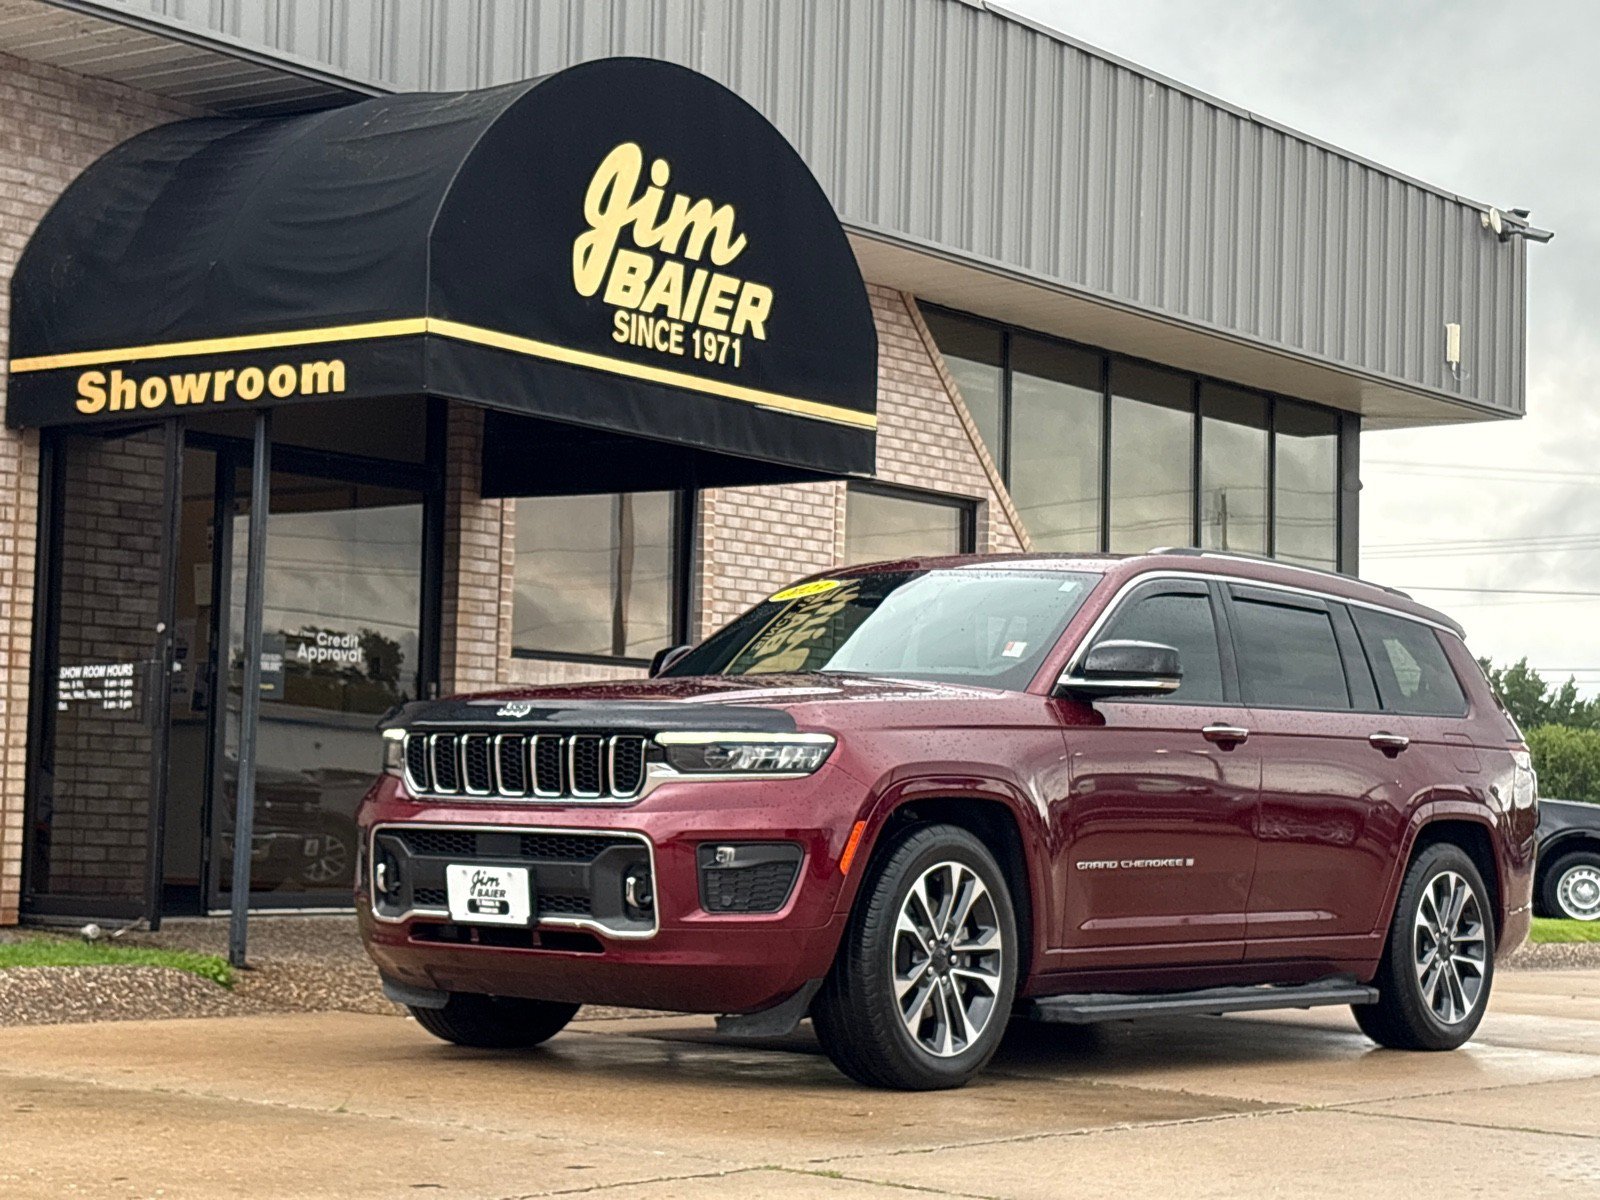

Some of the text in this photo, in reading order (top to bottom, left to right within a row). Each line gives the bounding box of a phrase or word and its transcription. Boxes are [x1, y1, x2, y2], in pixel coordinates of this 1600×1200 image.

[573, 142, 748, 298] Jim
[602, 248, 774, 341] BAIER
[611, 309, 742, 369] SINCE 1971
[75, 358, 346, 414] Showroom
[297, 642, 363, 663] Approval
[316, 632, 360, 649] Credit
[60, 663, 133, 679] SHOW ROOM HOURS
[1076, 861, 1118, 870] GRAND
[1120, 858, 1184, 868] CHEROKEE
[469, 869, 501, 896] Jim
[477, 888, 506, 898] BAIER
